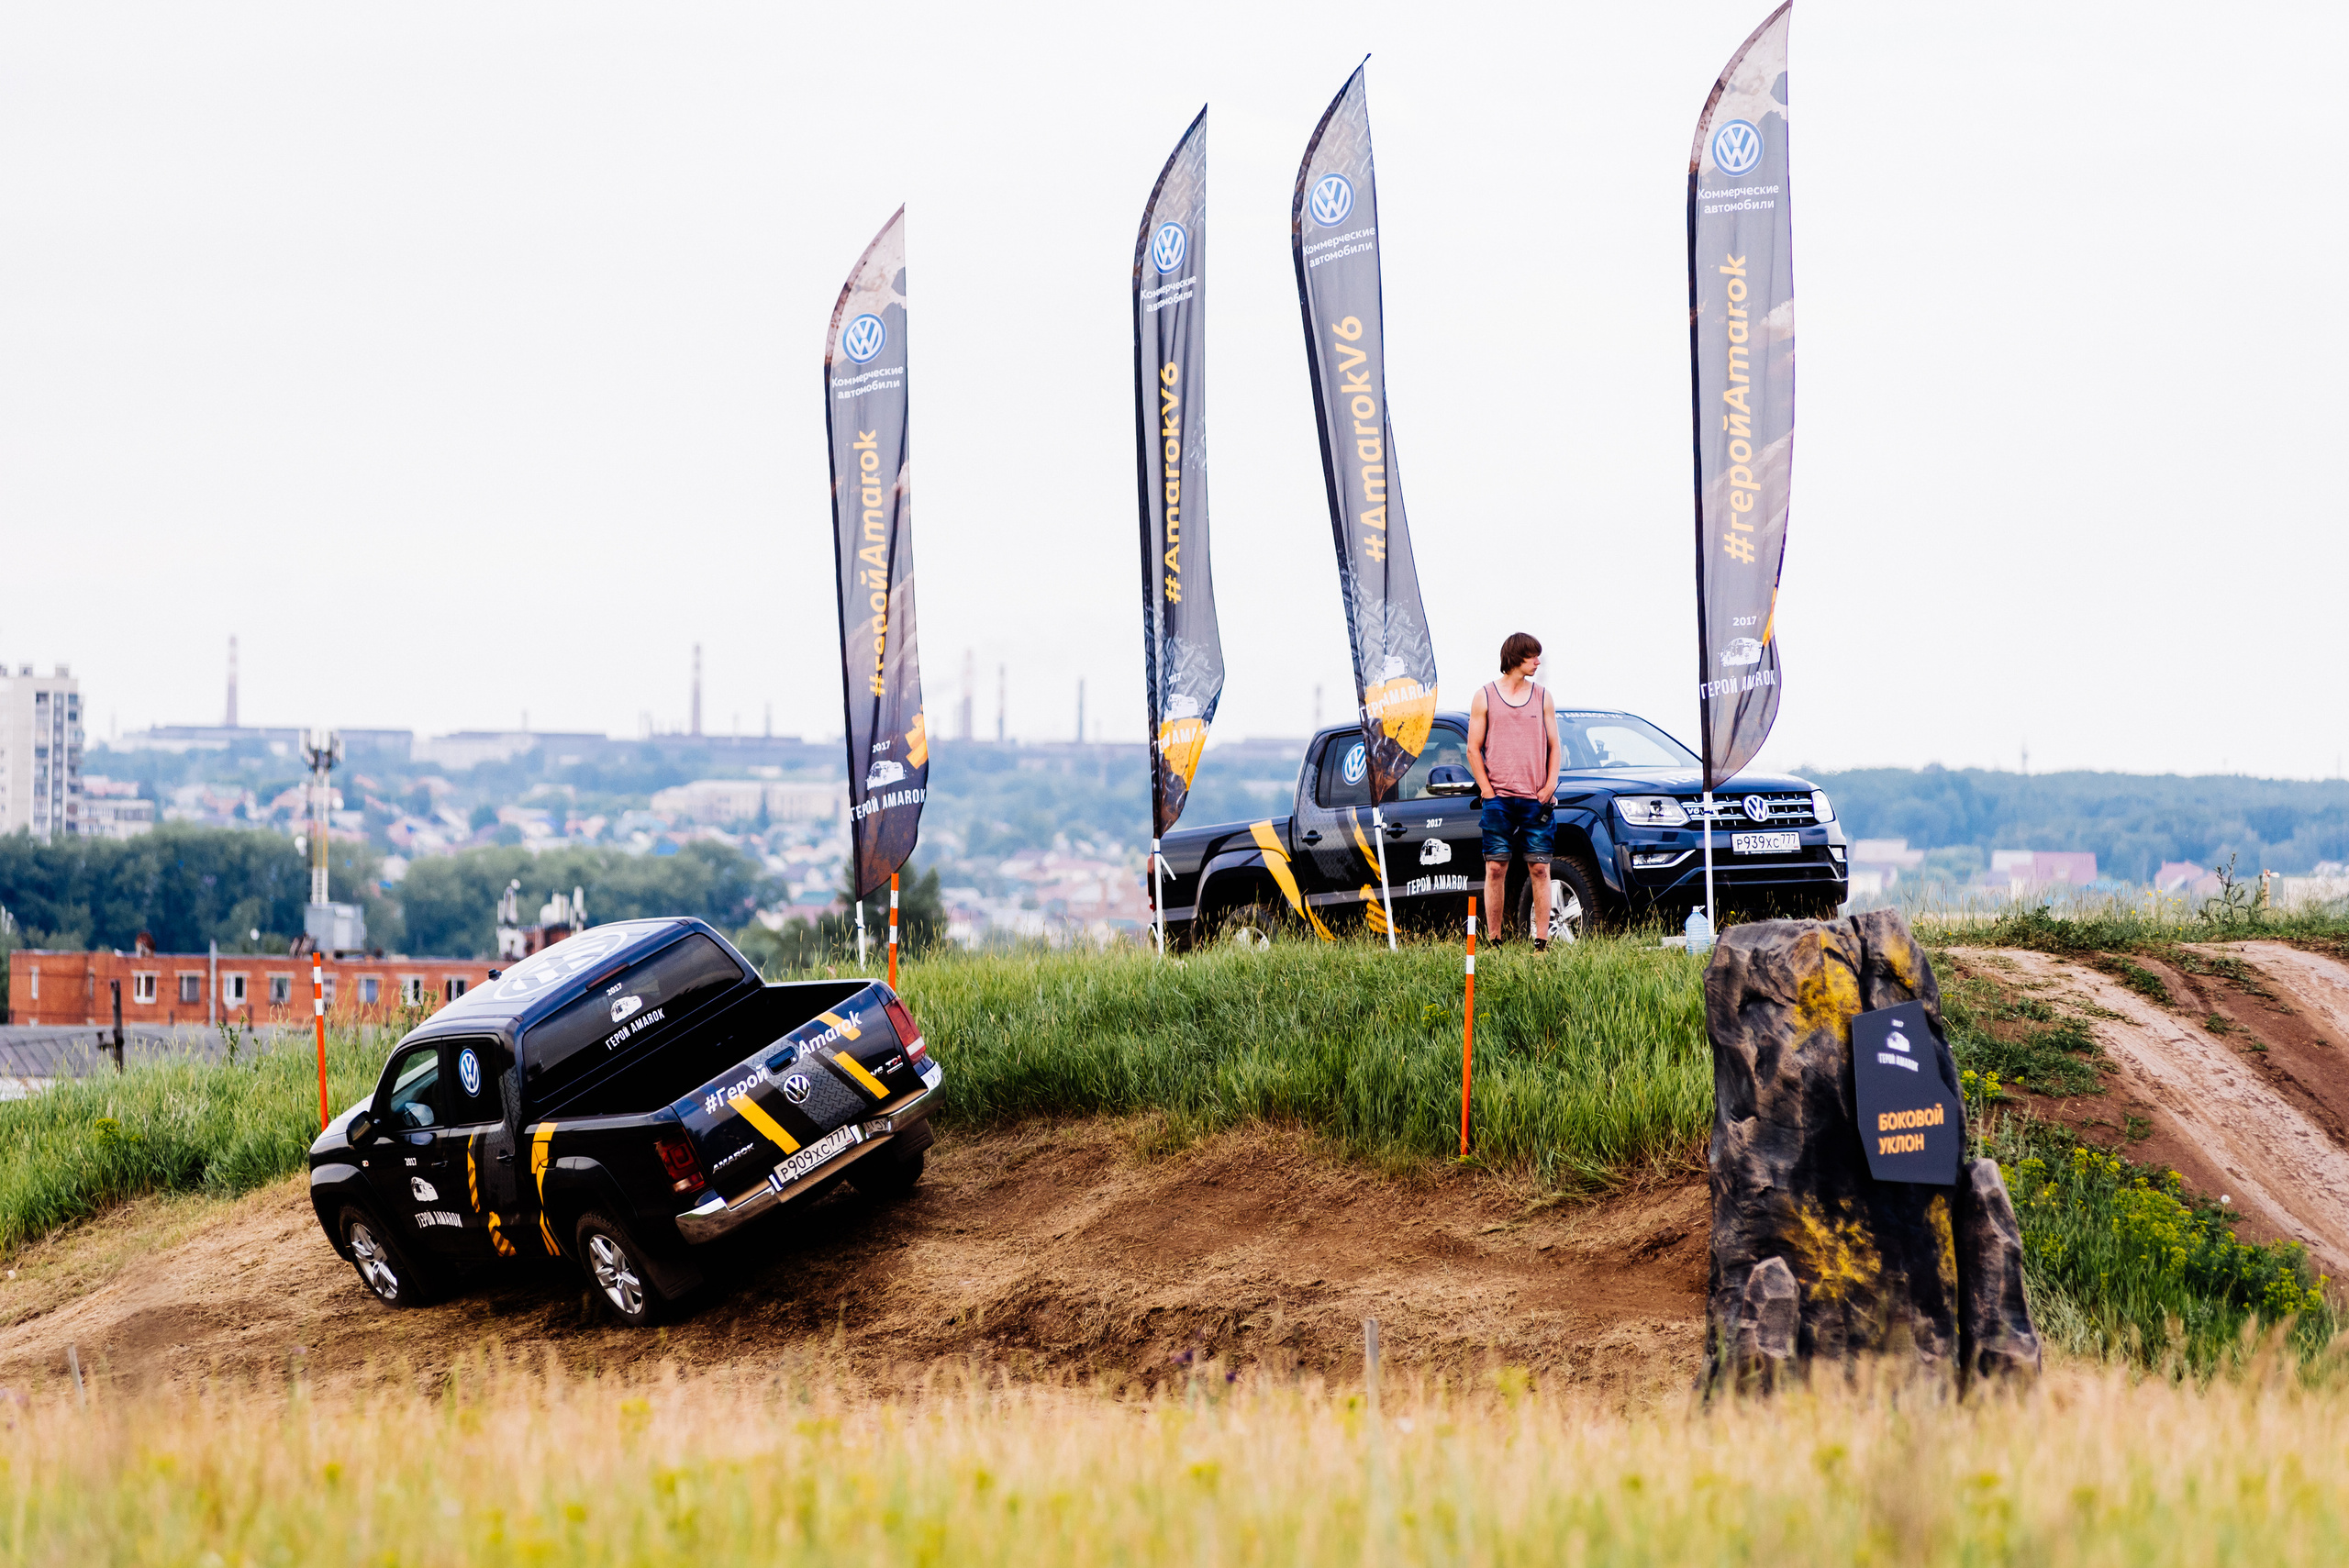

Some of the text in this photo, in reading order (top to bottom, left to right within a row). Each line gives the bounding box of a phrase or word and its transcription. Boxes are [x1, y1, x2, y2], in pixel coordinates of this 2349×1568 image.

[1698, 184, 1779, 199] Коммерческие
[1704, 198, 1775, 214] автомобили
[1303, 227, 1375, 256] Коммерческие
[1309, 241, 1374, 268] автомобили
[1141, 275, 1197, 299] Коммерческие
[1146, 290, 1193, 312] автомобили
[831, 366, 904, 388] Коммерческие
[838, 379, 900, 399] автомобили
[1332, 315, 1387, 563] #AmarokV6
[1160, 361, 1182, 605] #AmarokV6
[1732, 616, 1757, 626] 2017
[1700, 675, 1738, 700] ГЕРОЙ
[1359, 698, 1384, 722] ГЕРО
[872, 740, 891, 753] 2017
[850, 788, 926, 822] ГЕРОЙ AMAROK
[1426, 817, 1443, 828] 2017
[1407, 874, 1469, 896] ГЕРОЙ AMAROK
[606, 982, 622, 996] 2017
[605, 1007, 665, 1051] ГЕРОЙ AMAROK
[704, 1010, 863, 1115] #Герой Amarok
[885, 1054, 902, 1068] TDI
[1877, 1103, 1944, 1131] БОКОВОЙ
[1877, 1132, 1925, 1155] УКЛОН
[404, 1157, 417, 1167] 2017
[712, 1142, 754, 1174] AMAROK
[415, 1209, 437, 1229] ГЕРОЙ
